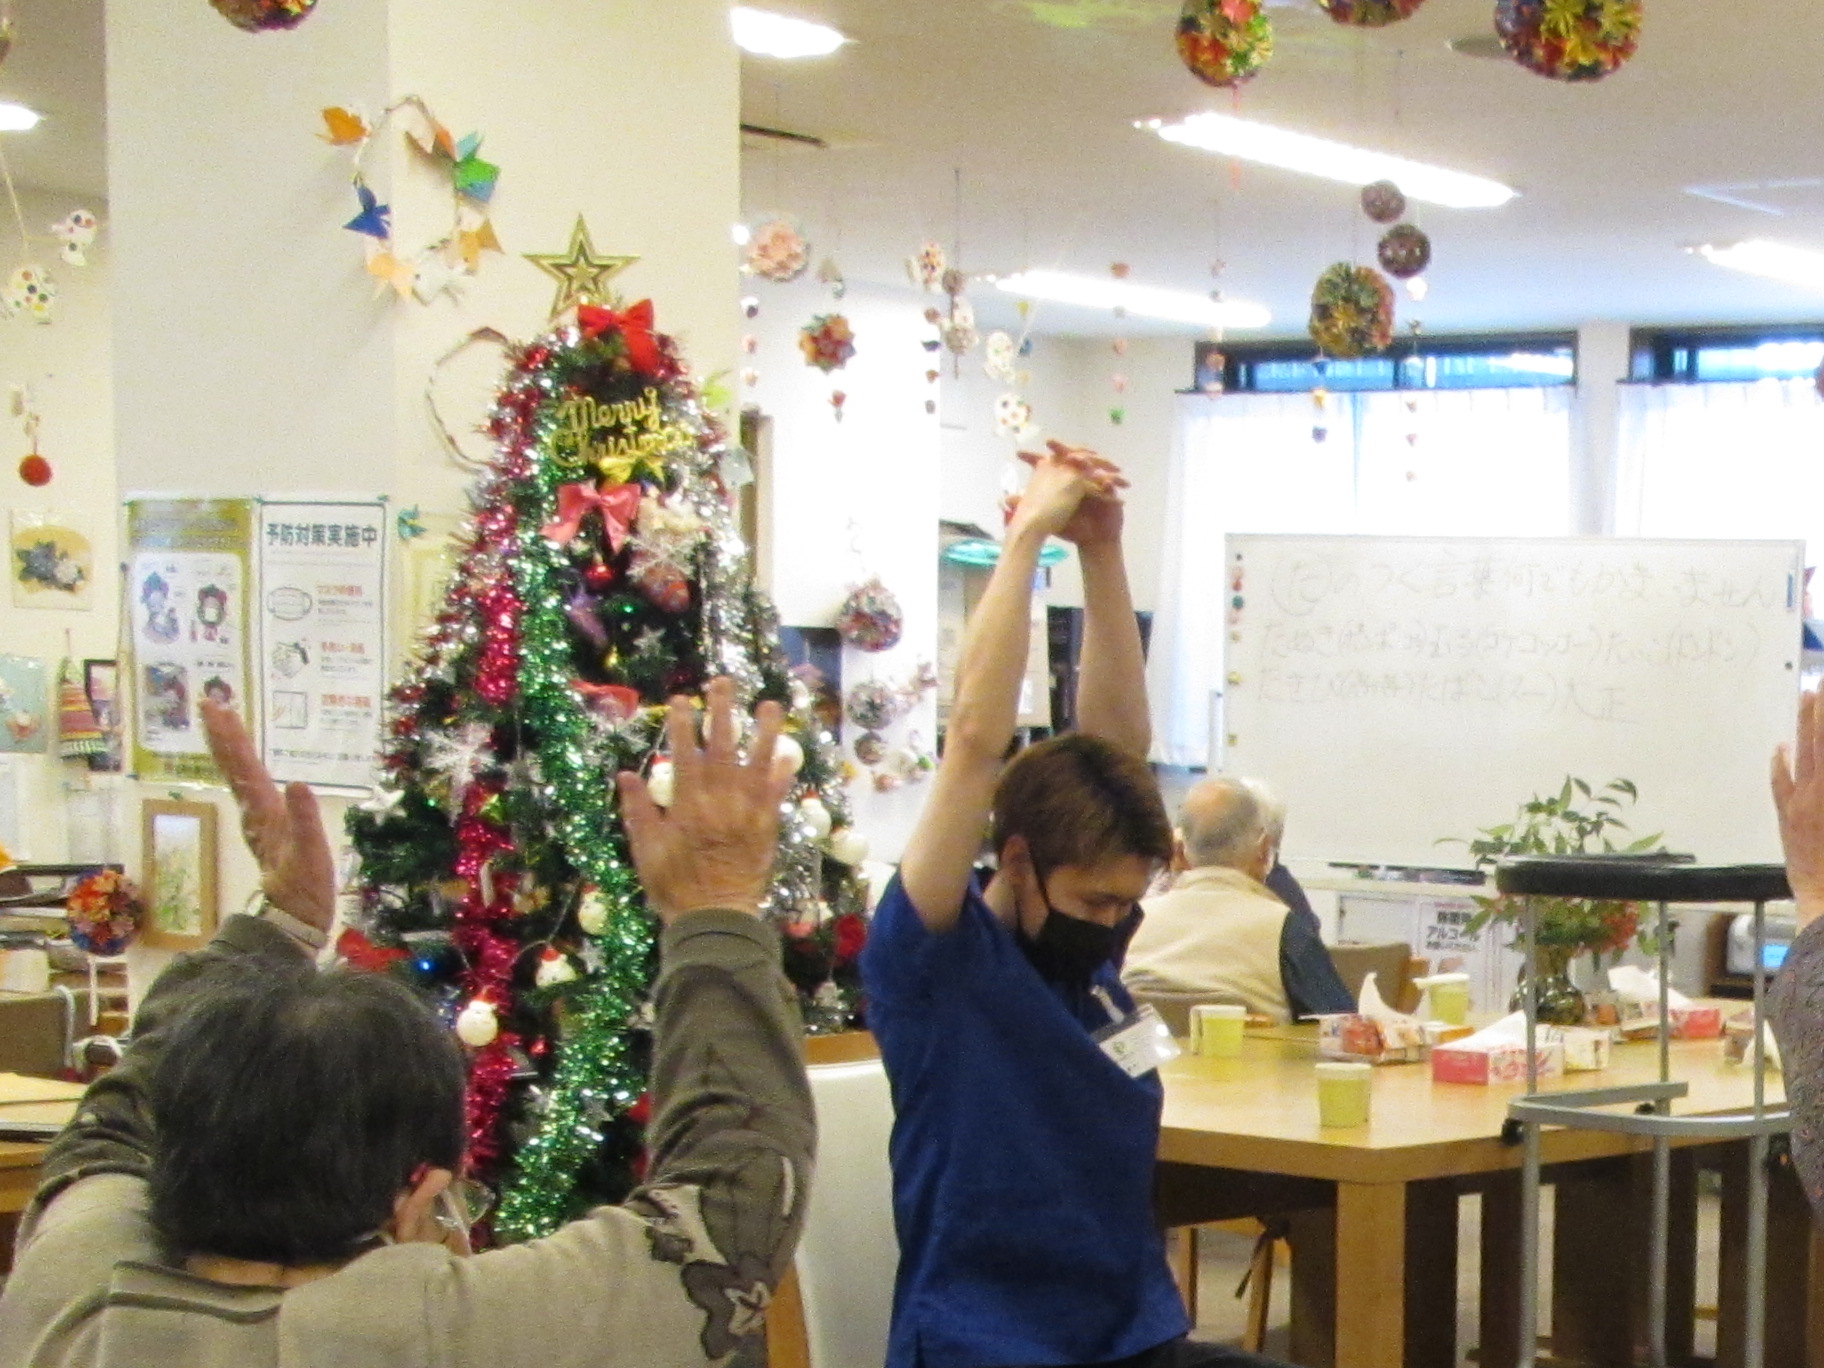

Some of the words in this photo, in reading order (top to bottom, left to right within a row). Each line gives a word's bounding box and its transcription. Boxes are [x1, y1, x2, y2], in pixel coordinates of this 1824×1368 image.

[555, 387, 662, 432] Merry
[266, 523, 378, 548] 予防対策実施中
[1426, 925, 1481, 942] アルコル
